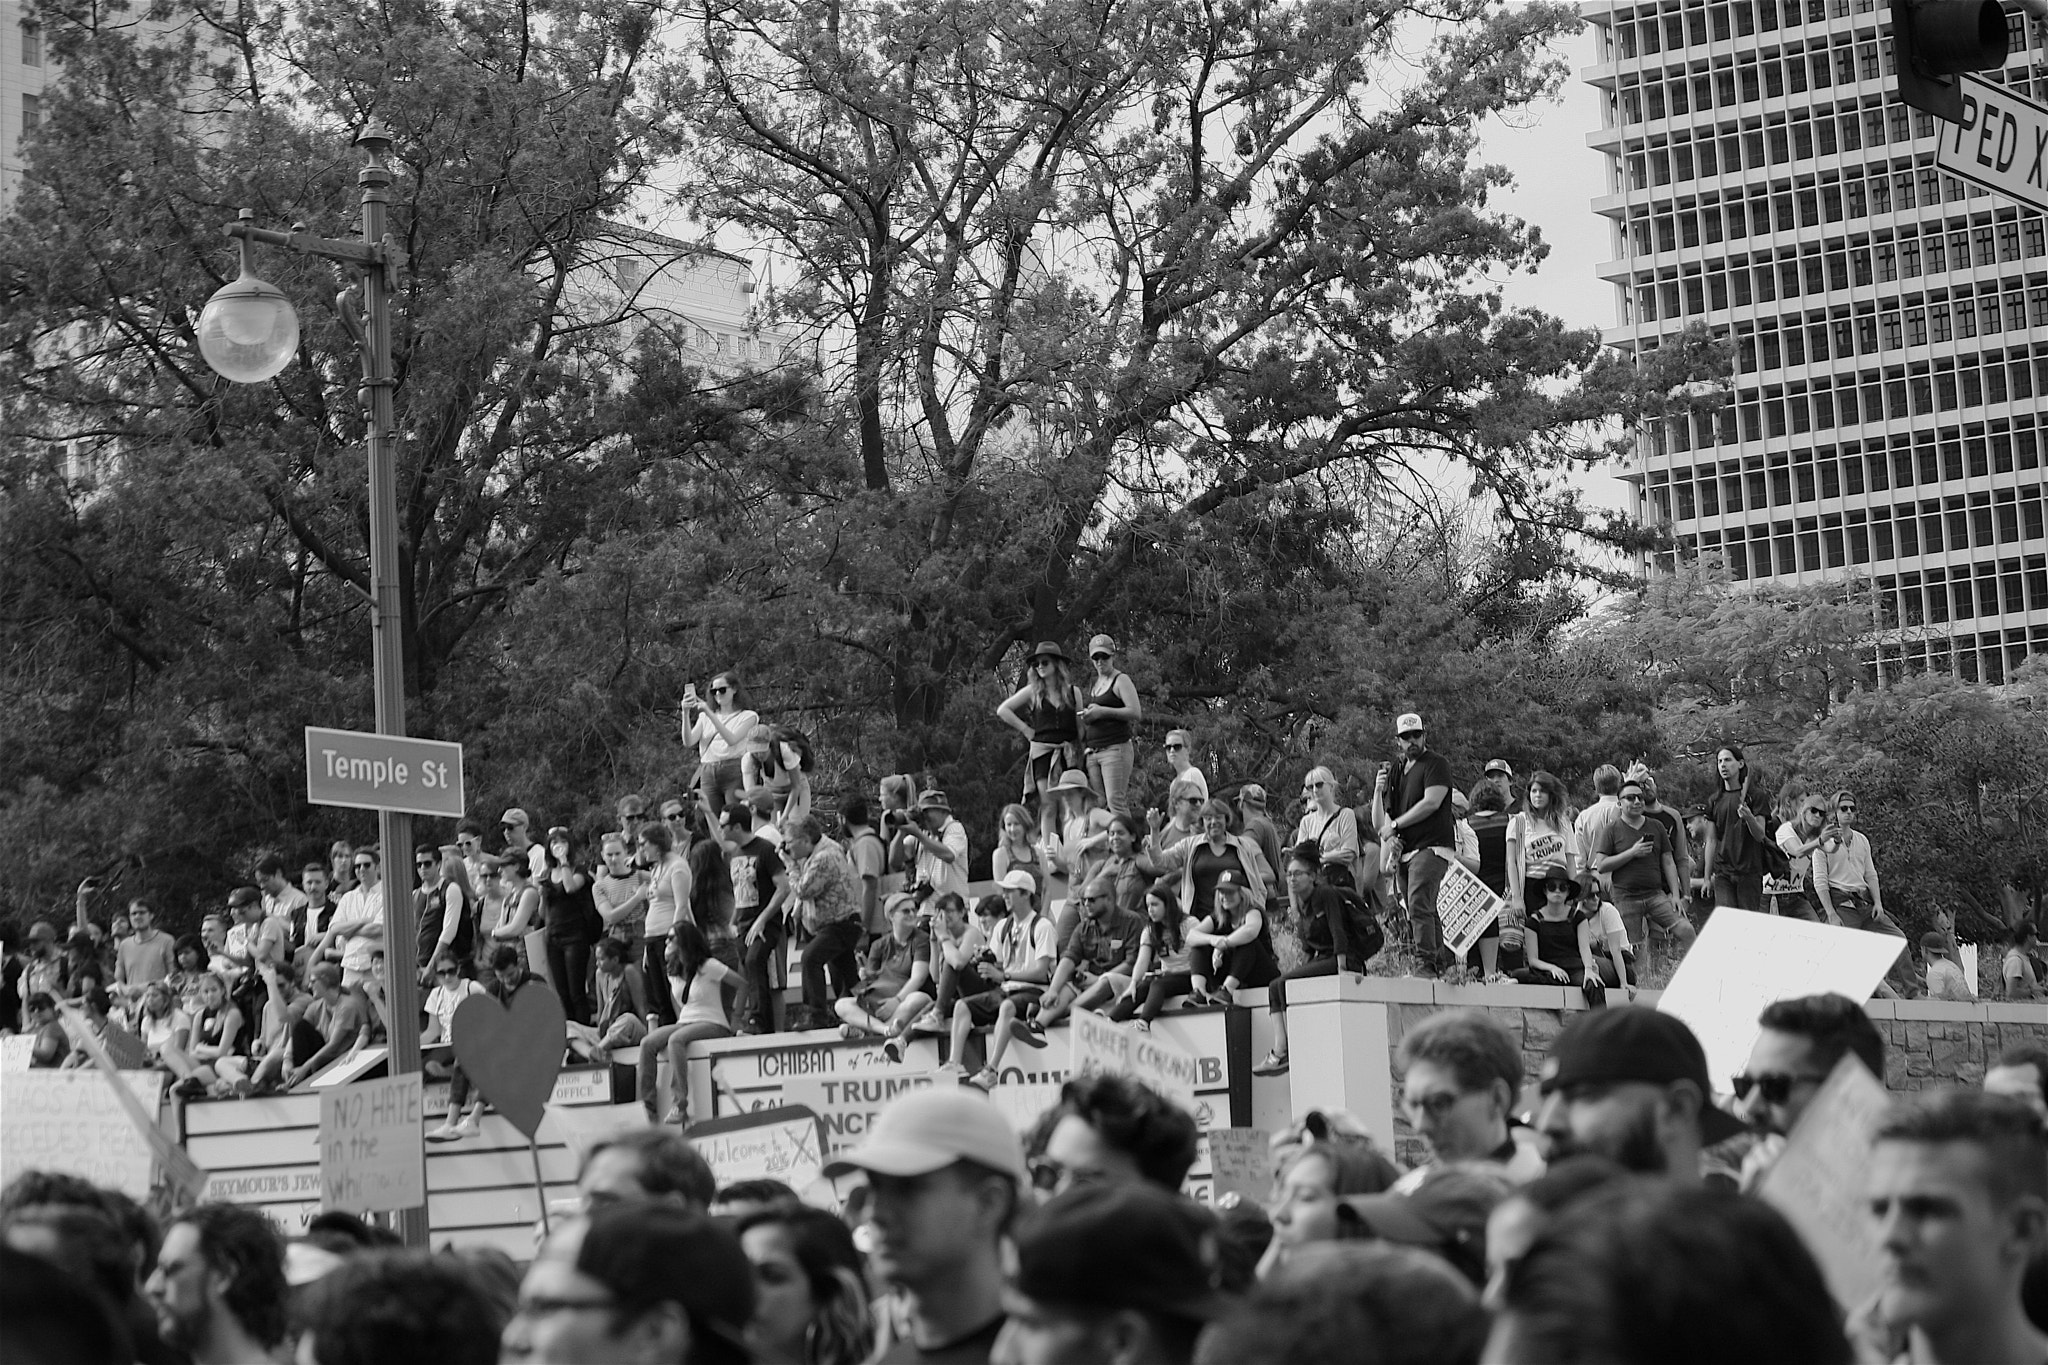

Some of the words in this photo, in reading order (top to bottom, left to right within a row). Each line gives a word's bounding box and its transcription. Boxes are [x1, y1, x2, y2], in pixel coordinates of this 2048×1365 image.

[1954, 93, 2018, 173] PED
[2026, 125, 2048, 193] X
[322, 749, 409, 790] Temple
[421, 760, 448, 790] St
[1530, 841, 1563, 861] TRUMP
[1446, 872, 1460, 887] nos
[1442, 898, 1466, 926] aceptar
[1467, 884, 1478, 896] un
[1444, 911, 1469, 940] Estados
[1464, 889, 1488, 914] Unidos
[1460, 907, 1487, 937] fascista
[758, 1048, 835, 1078] ICHIBAN
[848, 1054, 860, 1071] of
[864, 1052, 891, 1068] Toky
[334, 1092, 363, 1129] NO
[371, 1081, 418, 1128] HATE
[556, 1086, 594, 1099] OFFICE
[328, 1133, 343, 1163] in
[350, 1130, 378, 1161] the
[209, 1176, 290, 1198] SEYMOUR'S
[292, 1173, 320, 1191] JEW
